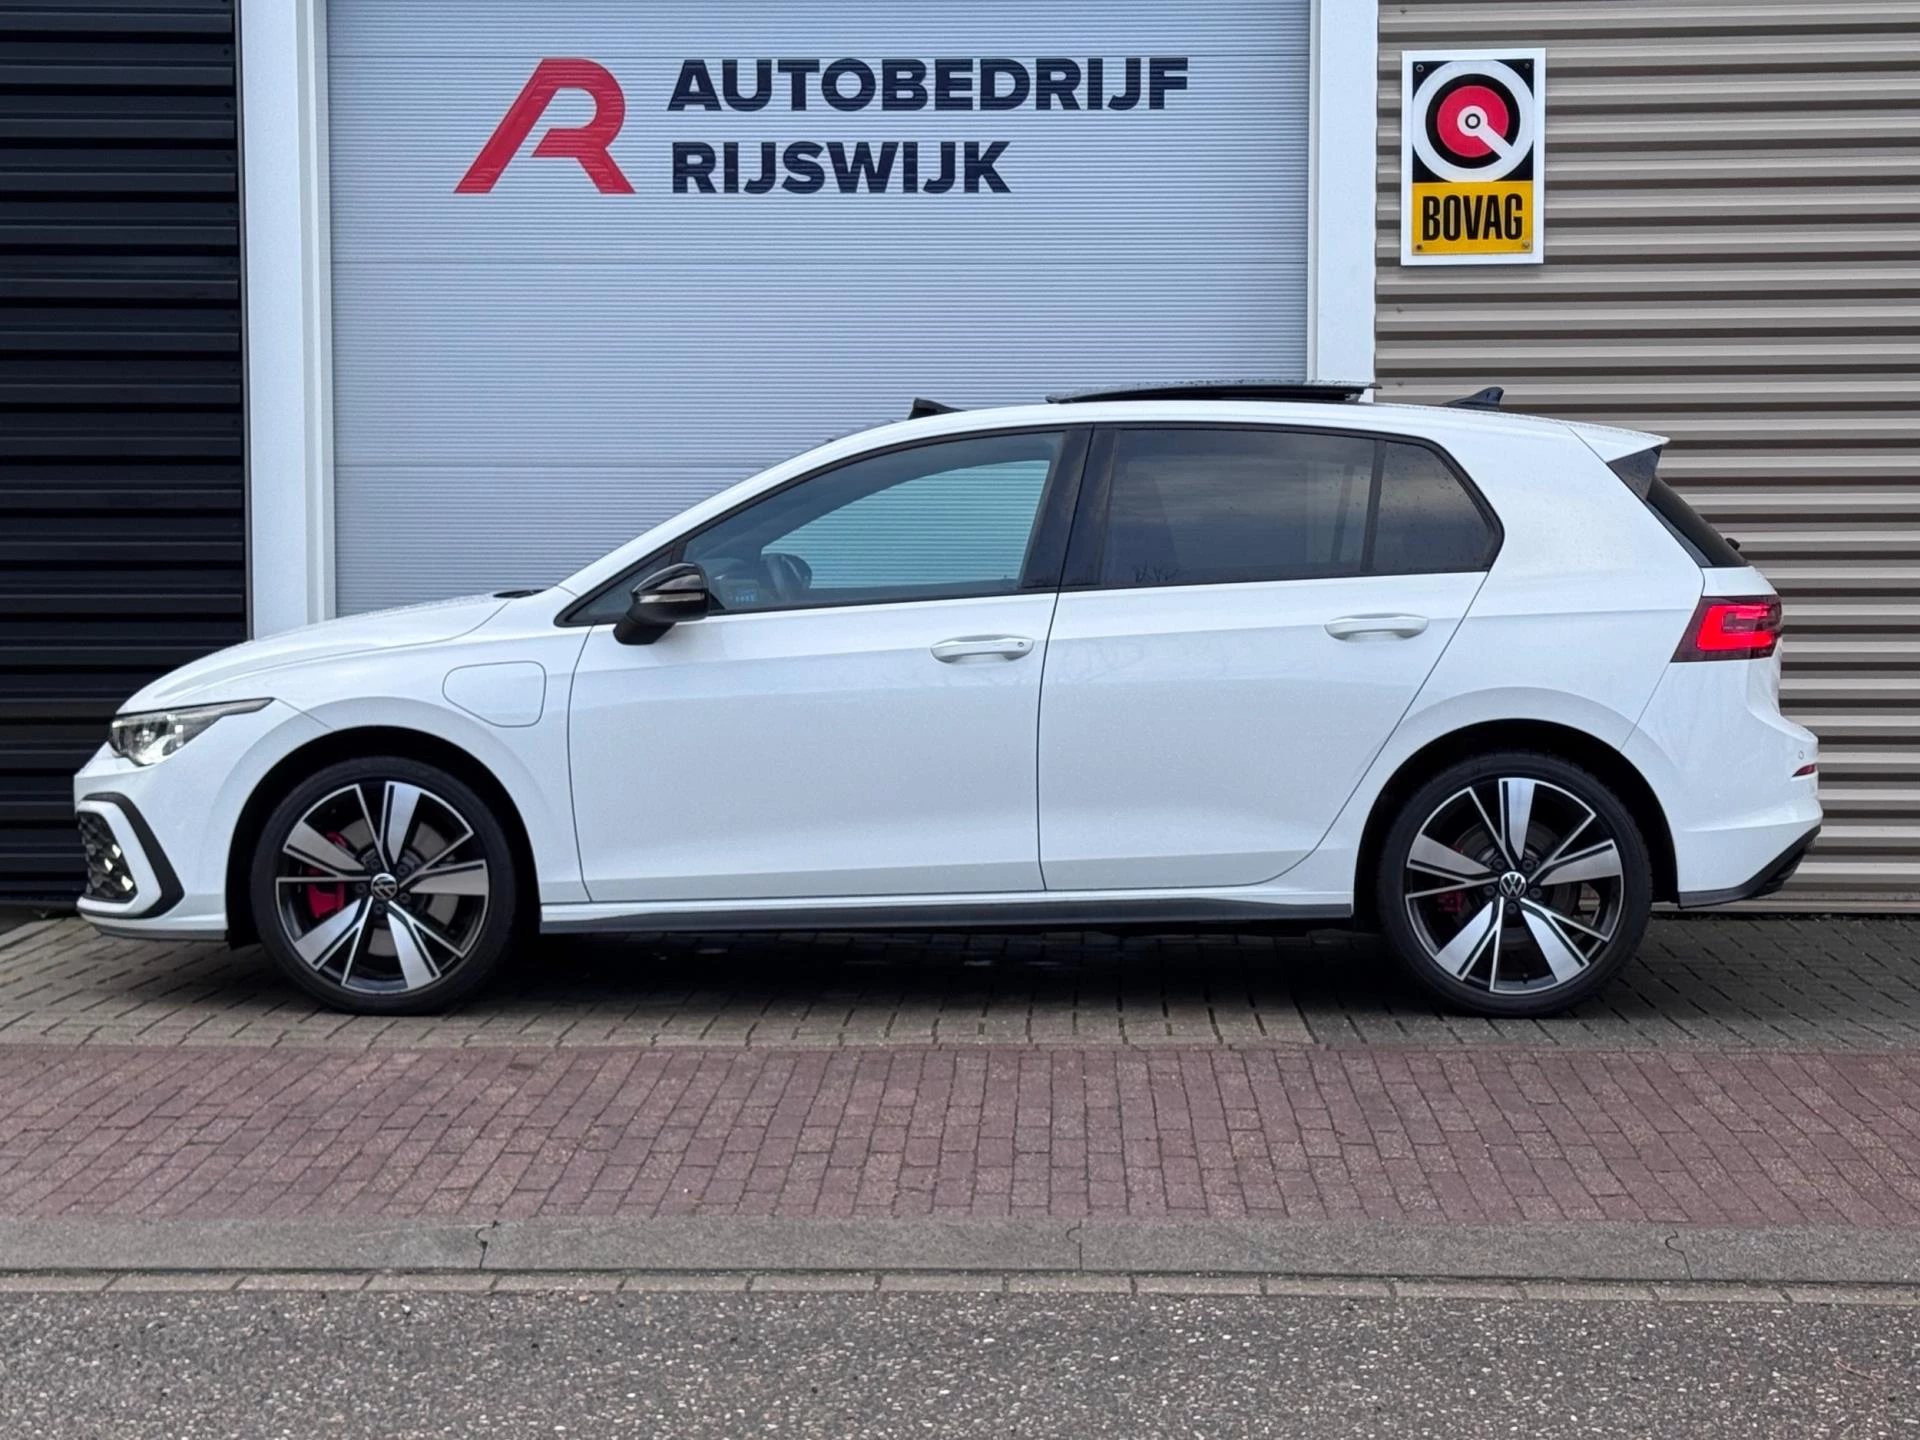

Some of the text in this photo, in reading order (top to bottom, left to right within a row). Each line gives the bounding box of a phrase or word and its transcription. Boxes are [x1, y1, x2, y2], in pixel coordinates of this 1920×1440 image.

[667, 57, 1189, 112] AUTOBEDRIJF
[672, 141, 1011, 194] RIJSWIJK
[1422, 193, 1523, 241] BOVAG
